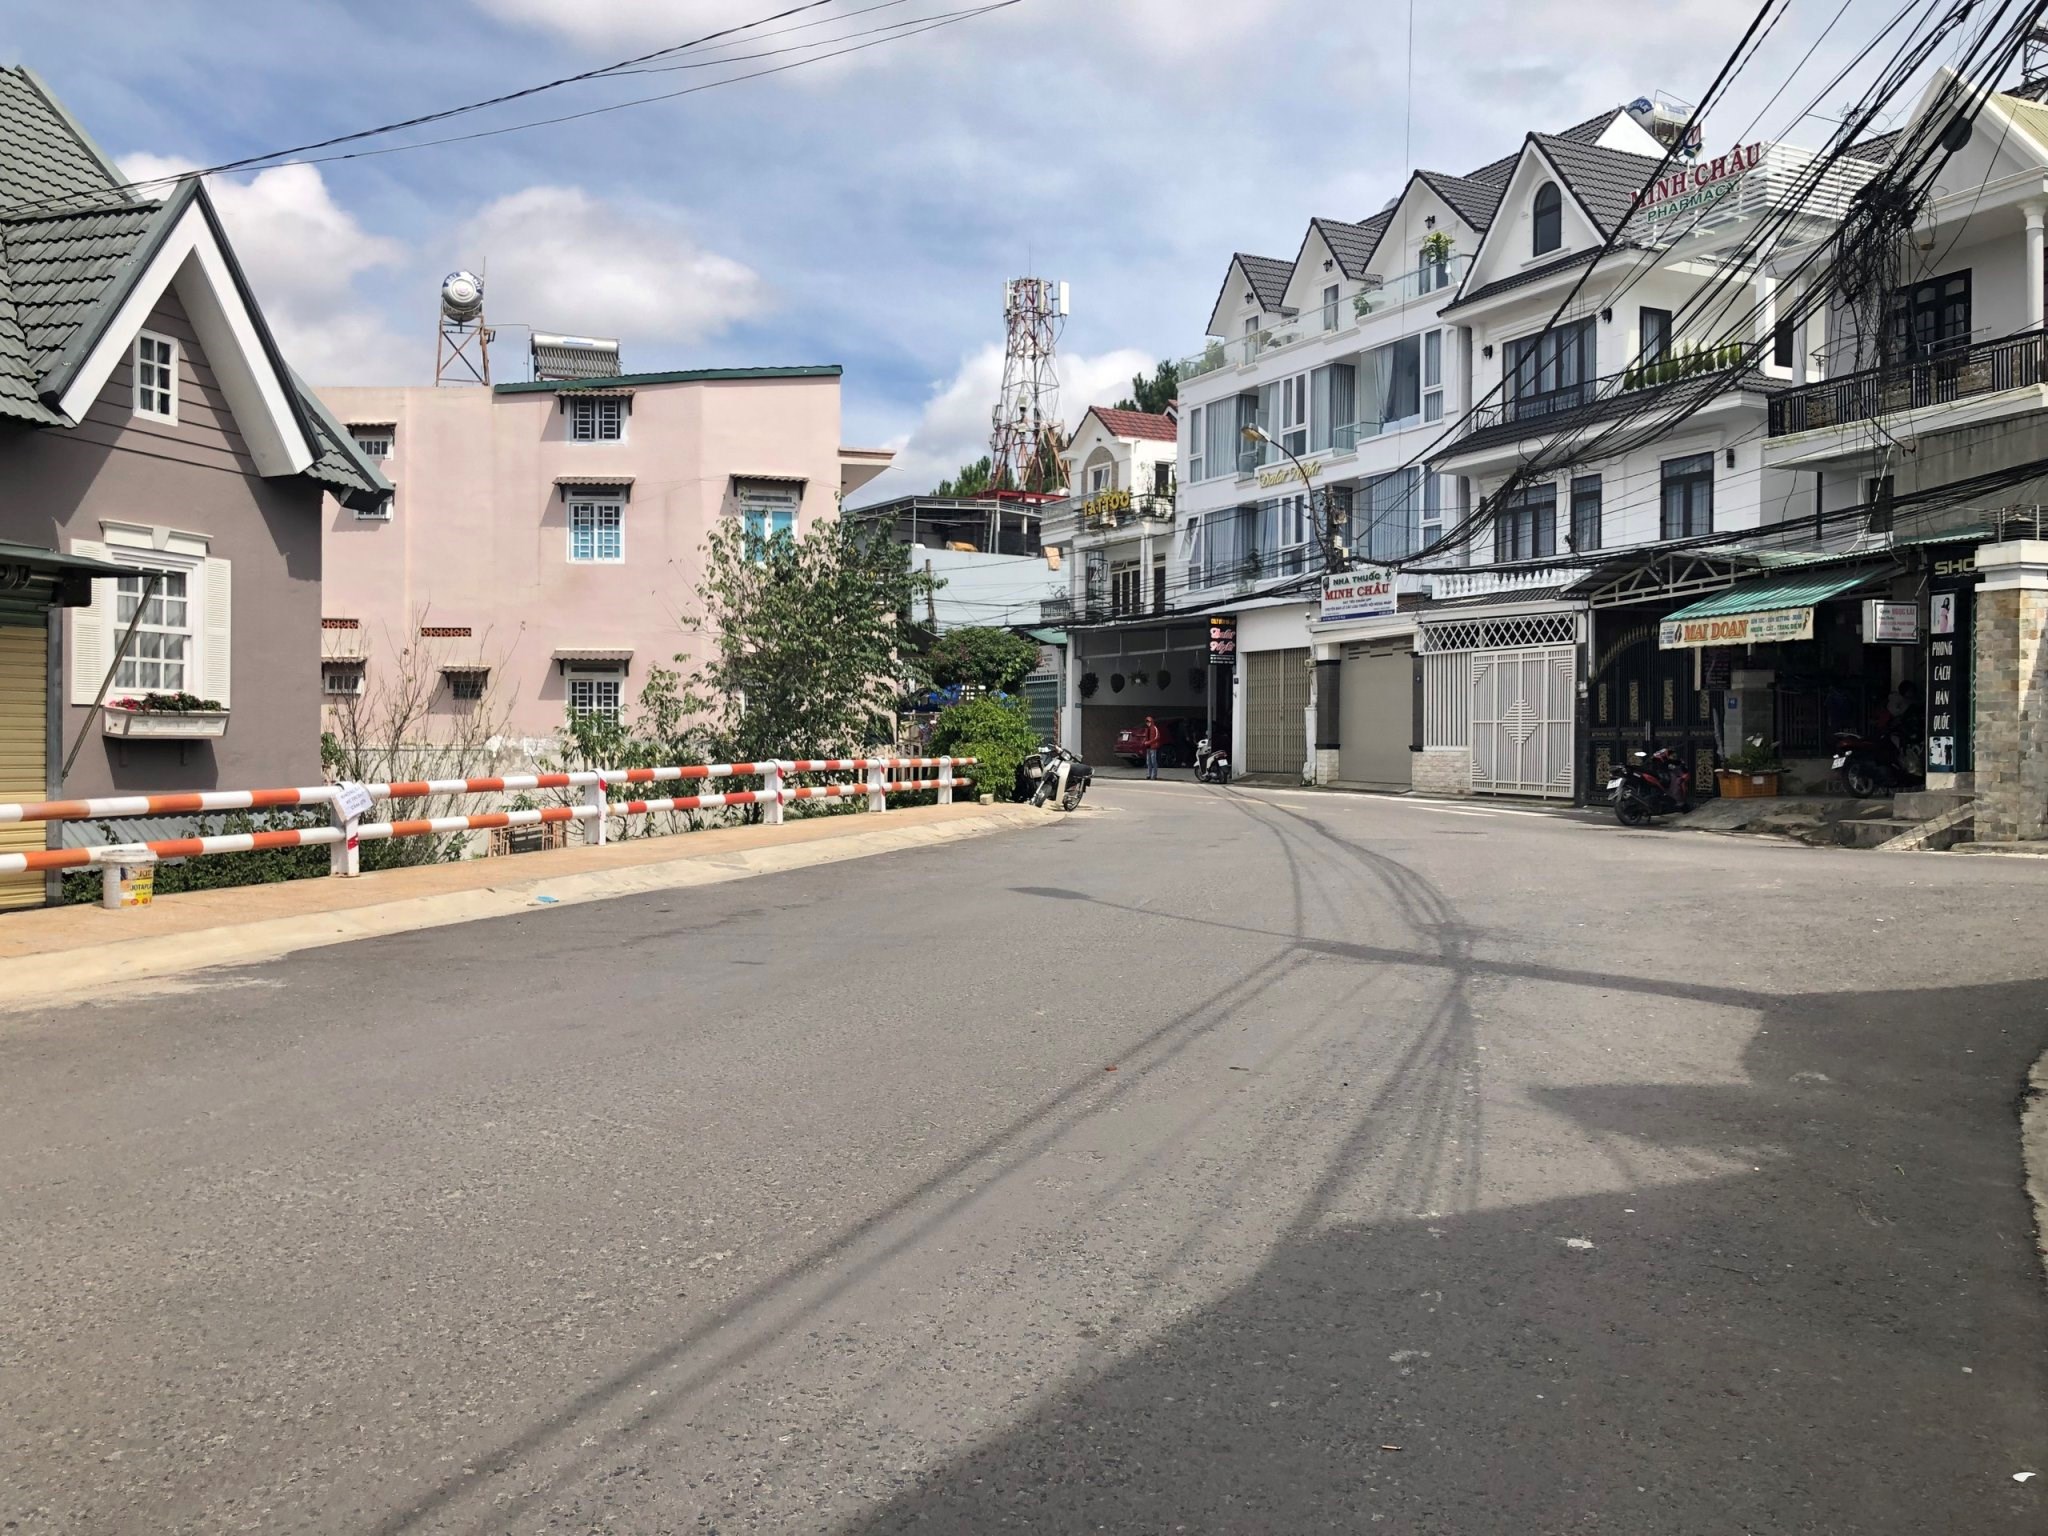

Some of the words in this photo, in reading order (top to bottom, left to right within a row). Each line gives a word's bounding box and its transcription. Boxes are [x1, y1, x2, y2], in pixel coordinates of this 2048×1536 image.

[1630, 171, 1687, 208] MINH
[1694, 142, 1761, 186] CHÂU
[1647, 181, 1738, 222] PHARMACY
[1083, 491, 1130, 516] TATTOO
[1325, 588, 1354, 600] MINH
[1357, 582, 1390, 597] CHÂU
[1684, 624, 1709, 642] MAI
[1932, 641, 1953, 656] PHONG
[1934, 664, 1951, 680] CÁCH
